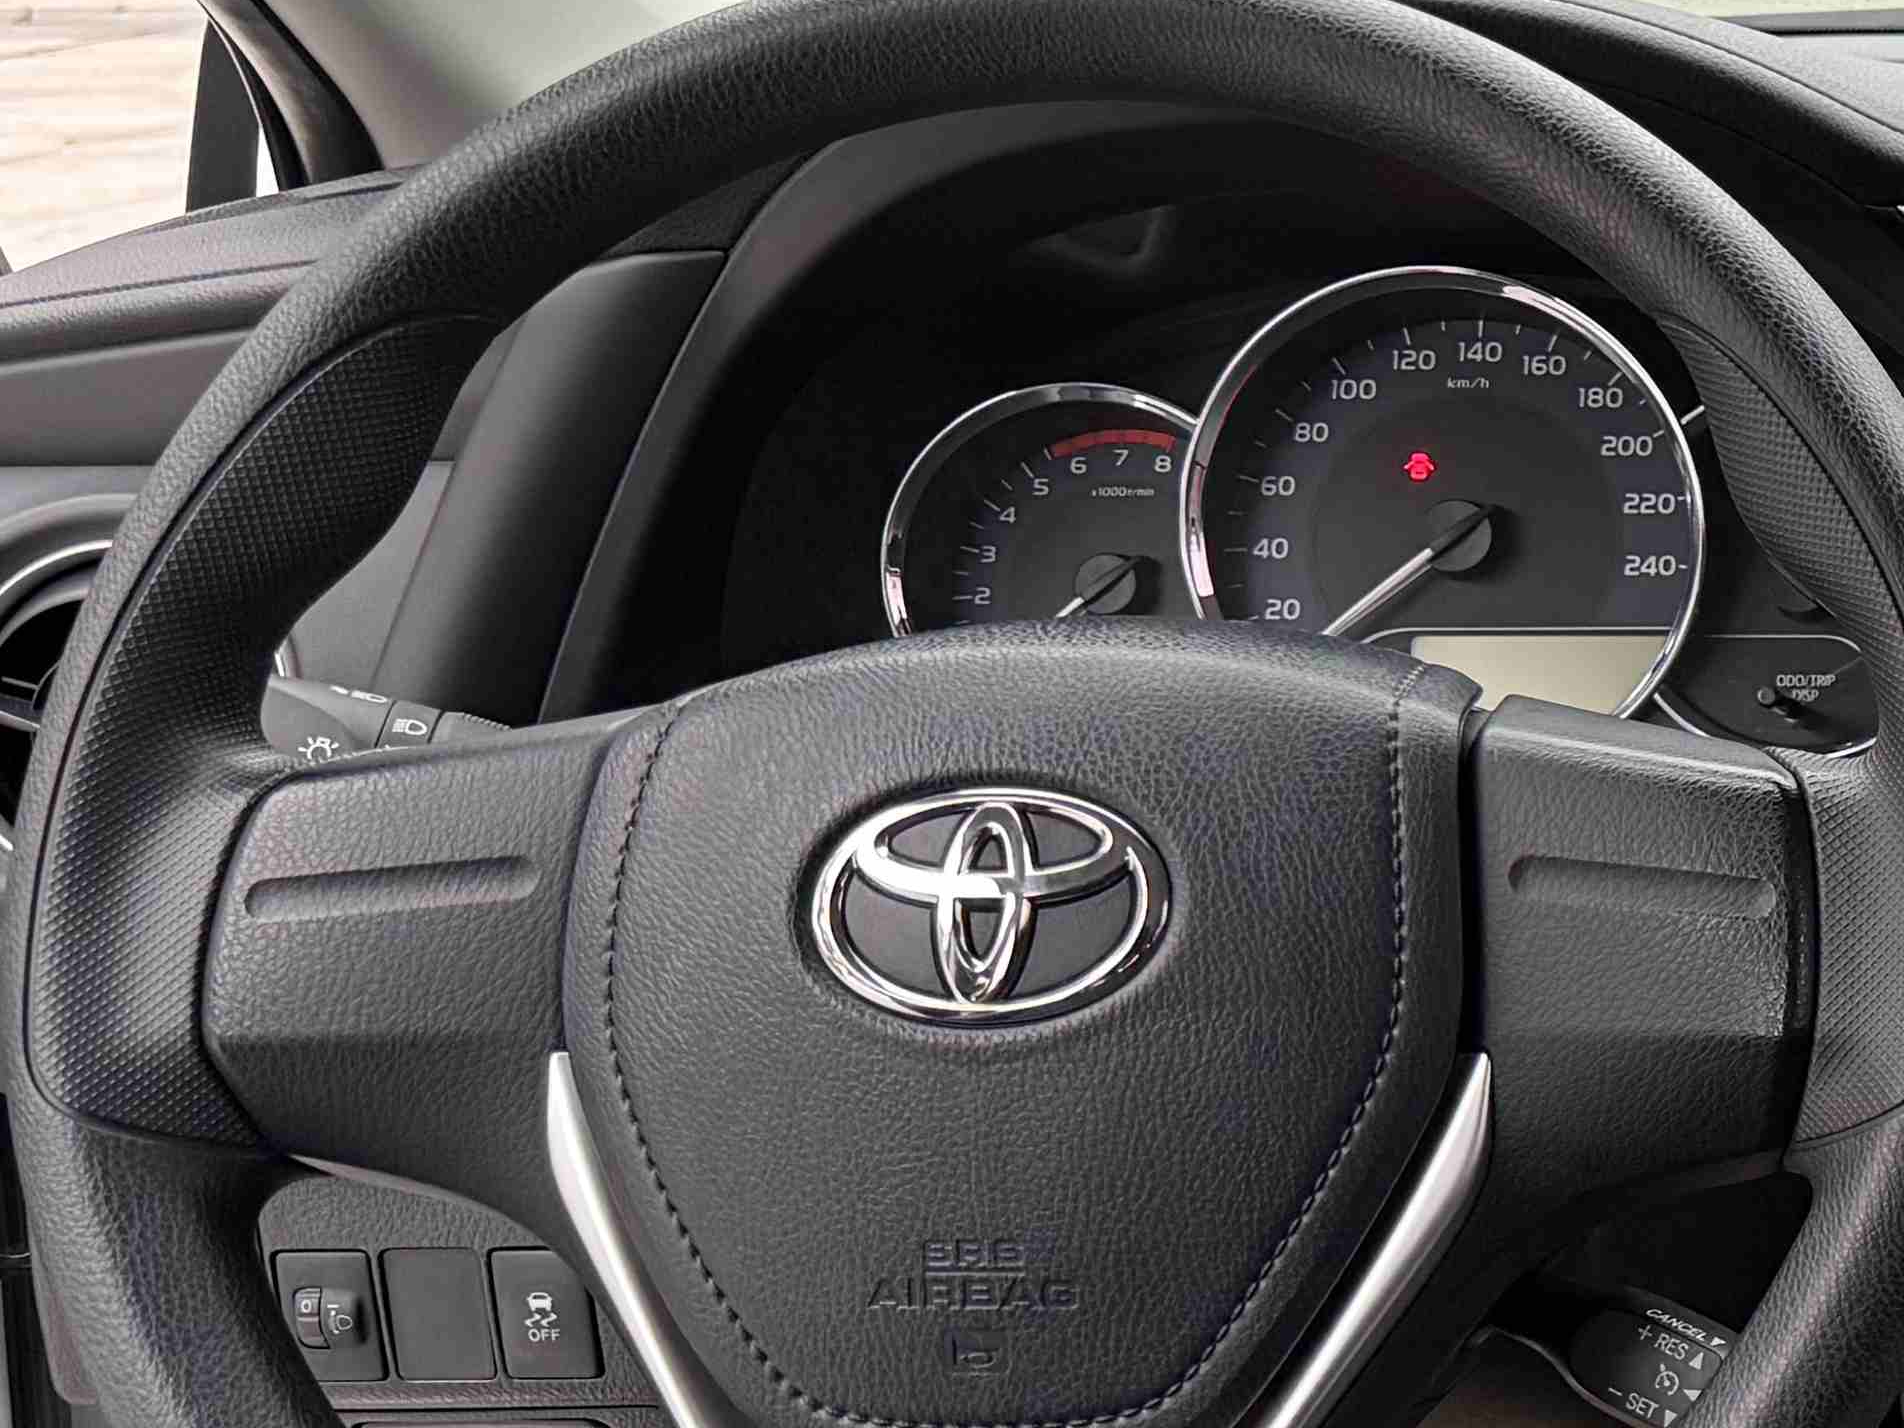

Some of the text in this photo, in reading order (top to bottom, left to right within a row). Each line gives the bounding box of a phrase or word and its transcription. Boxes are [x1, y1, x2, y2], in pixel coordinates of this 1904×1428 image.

[1392, 349, 1438, 372] 120
[1457, 341, 1504, 364] 140
[1521, 354, 1567, 377] 160
[1330, 377, 1378, 401] 100
[1447, 377, 1491, 390] km/h
[1577, 385, 1624, 409] 180
[1293, 420, 1330, 444] 80
[1600, 434, 1654, 457] 200
[1070, 457, 1088, 475] 6
[1113, 449, 1129, 467] 7
[1154, 455, 1172, 473] 8
[1032, 478, 1049, 496] 5
[1260, 474, 1297, 496] 60
[999, 506, 1016, 524] 4
[1622, 492, 1677, 516] 220
[979, 545, 997, 564] 3
[1252, 537, 1290, 559] 40
[1622, 554, 1678, 577] 240
[974, 587, 991, 605] 2
[1264, 598, 1301, 620] 20
[1776, 674, 1836, 687] ODO/TRIP
[867, 1278, 1078, 1310] AIRBAG
[528, 1328, 560, 1342] OFF
[1646, 1309, 1706, 1342] CANCEL
[1654, 1334, 1689, 1360] RES
[1626, 1393, 1659, 1419] SET
